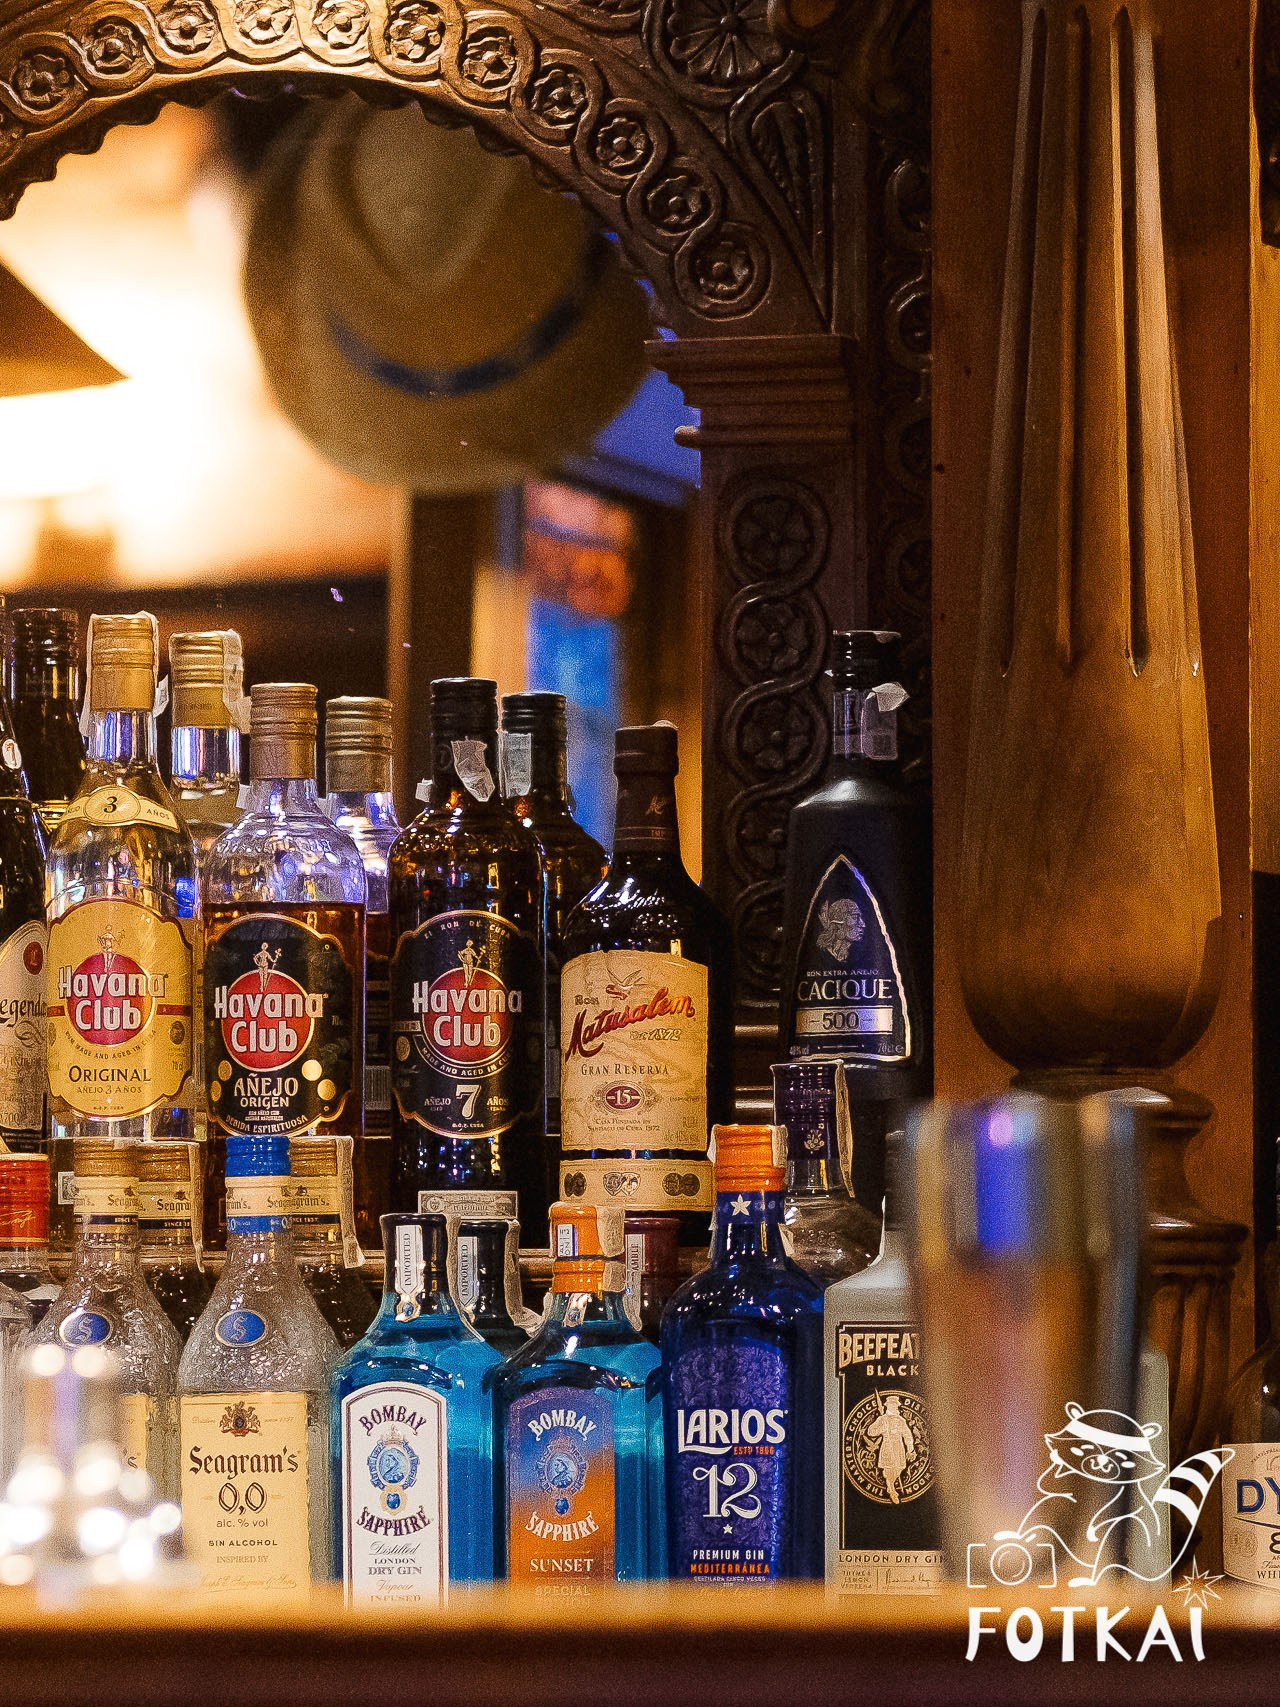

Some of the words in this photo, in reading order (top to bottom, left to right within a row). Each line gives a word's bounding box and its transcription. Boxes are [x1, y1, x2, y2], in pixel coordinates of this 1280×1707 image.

[104, 796, 118, 814] 3
[440, 920, 460, 931] RON
[58, 965, 168, 999] Havana
[823, 969, 848, 977] EXTRA
[412, 979, 523, 1014] Havana
[797, 978, 893, 1001] CACIQUE
[214, 985, 326, 1019] Havana
[74, 999, 142, 1032] Club
[565, 985, 696, 1064] Matusalem
[822, 1011, 860, 1030] 500
[230, 1020, 299, 1053] Club
[433, 1014, 502, 1048] Club
[94, 1052, 109, 1060] AND
[111, 1049, 132, 1059] AGED
[421, 1046, 439, 1066] MADE
[439, 1063, 459, 1075] AND
[460, 1068, 484, 1077] AGED
[487, 1063, 498, 1073] IN
[68, 1065, 152, 1083] ORIGINAL
[580, 1063, 609, 1076] GRAN
[614, 1062, 669, 1075] RESERVA
[77, 1085, 103, 1095] AÑEJO
[114, 1084, 143, 1094] AÑOS
[233, 1073, 299, 1097] AÑEJO
[239, 1096, 290, 1109] ORIGEN
[423, 1096, 452, 1107] AÑEJO
[455, 1084, 482, 1120] 7
[614, 1089, 632, 1106] 15
[252, 1114, 309, 1134] ESPIRITUOSA
[403, 1232, 412, 1287] IMPORTED
[460, 1243, 469, 1297] IMPORTED
[838, 1332, 920, 1369] BEEFEAT
[866, 1364, 920, 1377] BLACK
[358, 1404, 427, 1437] BOMBAY
[527, 1408, 598, 1442] BOMBAY
[848, 1400, 878, 1432] CHOICE
[676, 1408, 788, 1455] LARIOS
[189, 1445, 300, 1480] Seagram's
[218, 1481, 268, 1515] 0,0
[691, 1462, 762, 1520] 12
[216, 1519, 236, 1528] alc.
[252, 1517, 269, 1528] vol
[355, 1504, 434, 1537] SAPPHIRE
[524, 1510, 600, 1542] SAPPHIRE
[208, 1539, 225, 1547] SIN
[228, 1539, 279, 1547] ALCOHOL
[368, 1540, 421, 1557] Distilled
[216, 1555, 256, 1564] INSPIRED
[257, 1555, 269, 1564] BY
[529, 1557, 594, 1573] SUNSET
[693, 1549, 740, 1561] PREMIUM
[745, 1549, 765, 1561] GIN
[838, 1554, 890, 1563] LONDON
[894, 1555, 920, 1563] DRY
[367, 1566, 393, 1576] DRY
[396, 1566, 423, 1576] GIN
[689, 1561, 771, 1574] MEDITERRÁNEA
[535, 1585, 591, 1597] SPECIAL
